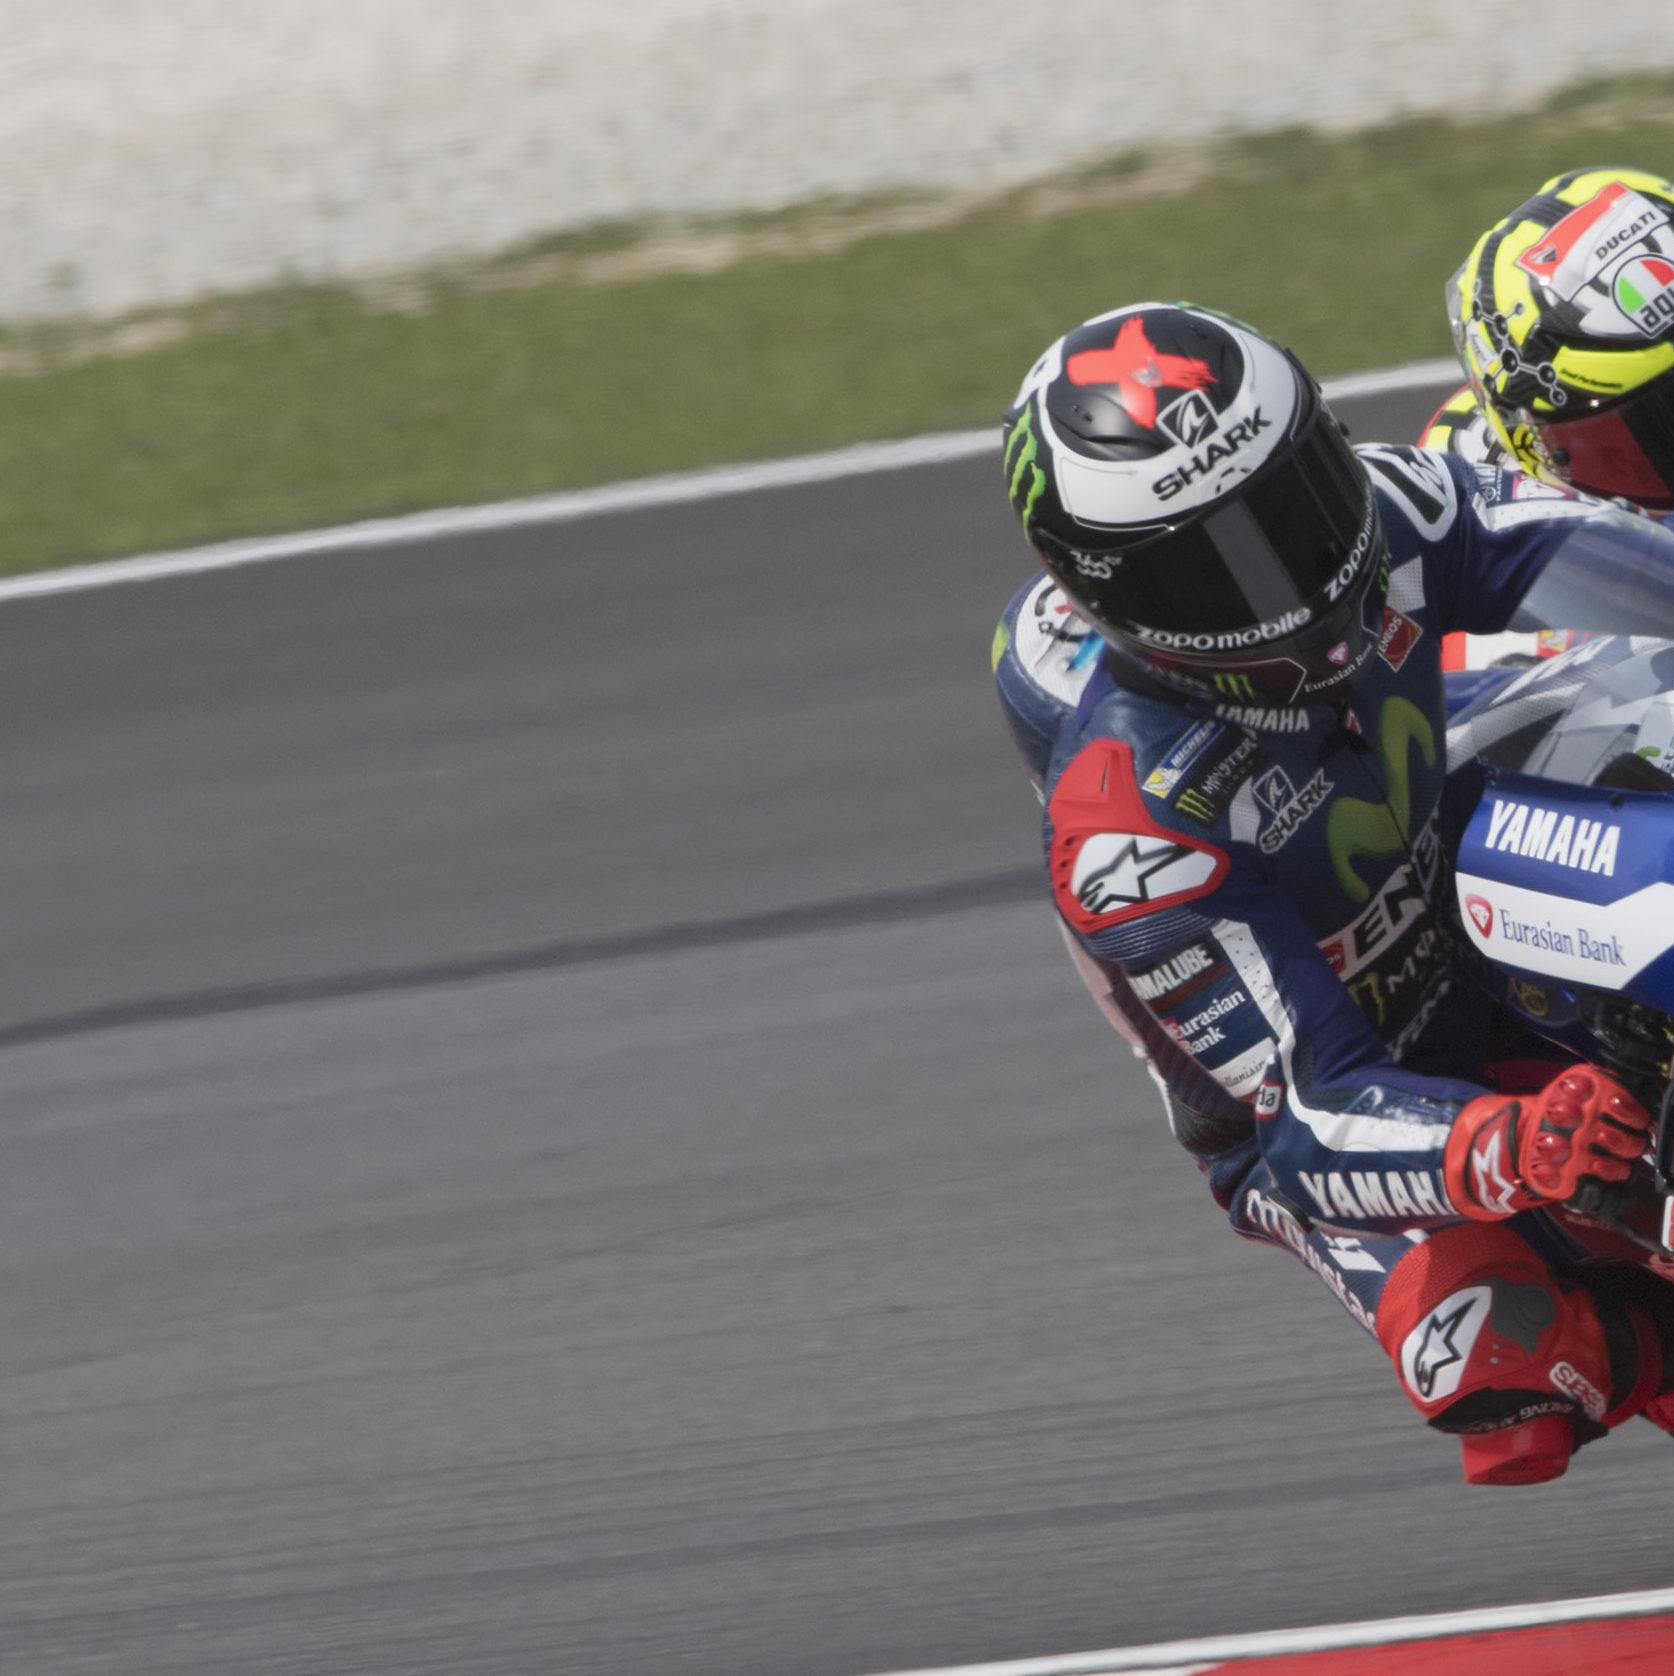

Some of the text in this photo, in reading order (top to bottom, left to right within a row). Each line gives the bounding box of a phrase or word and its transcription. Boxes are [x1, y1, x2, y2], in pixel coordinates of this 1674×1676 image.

[1595, 211, 1656, 260] DUCATI
[1152, 405, 1272, 501] SHARK
[1304, 663, 1357, 694] Eurasian
[1260, 770, 1333, 852] SHARK
[1484, 799, 1621, 877] YAMAHA
[1499, 908, 1627, 967] Eurasian Bank
